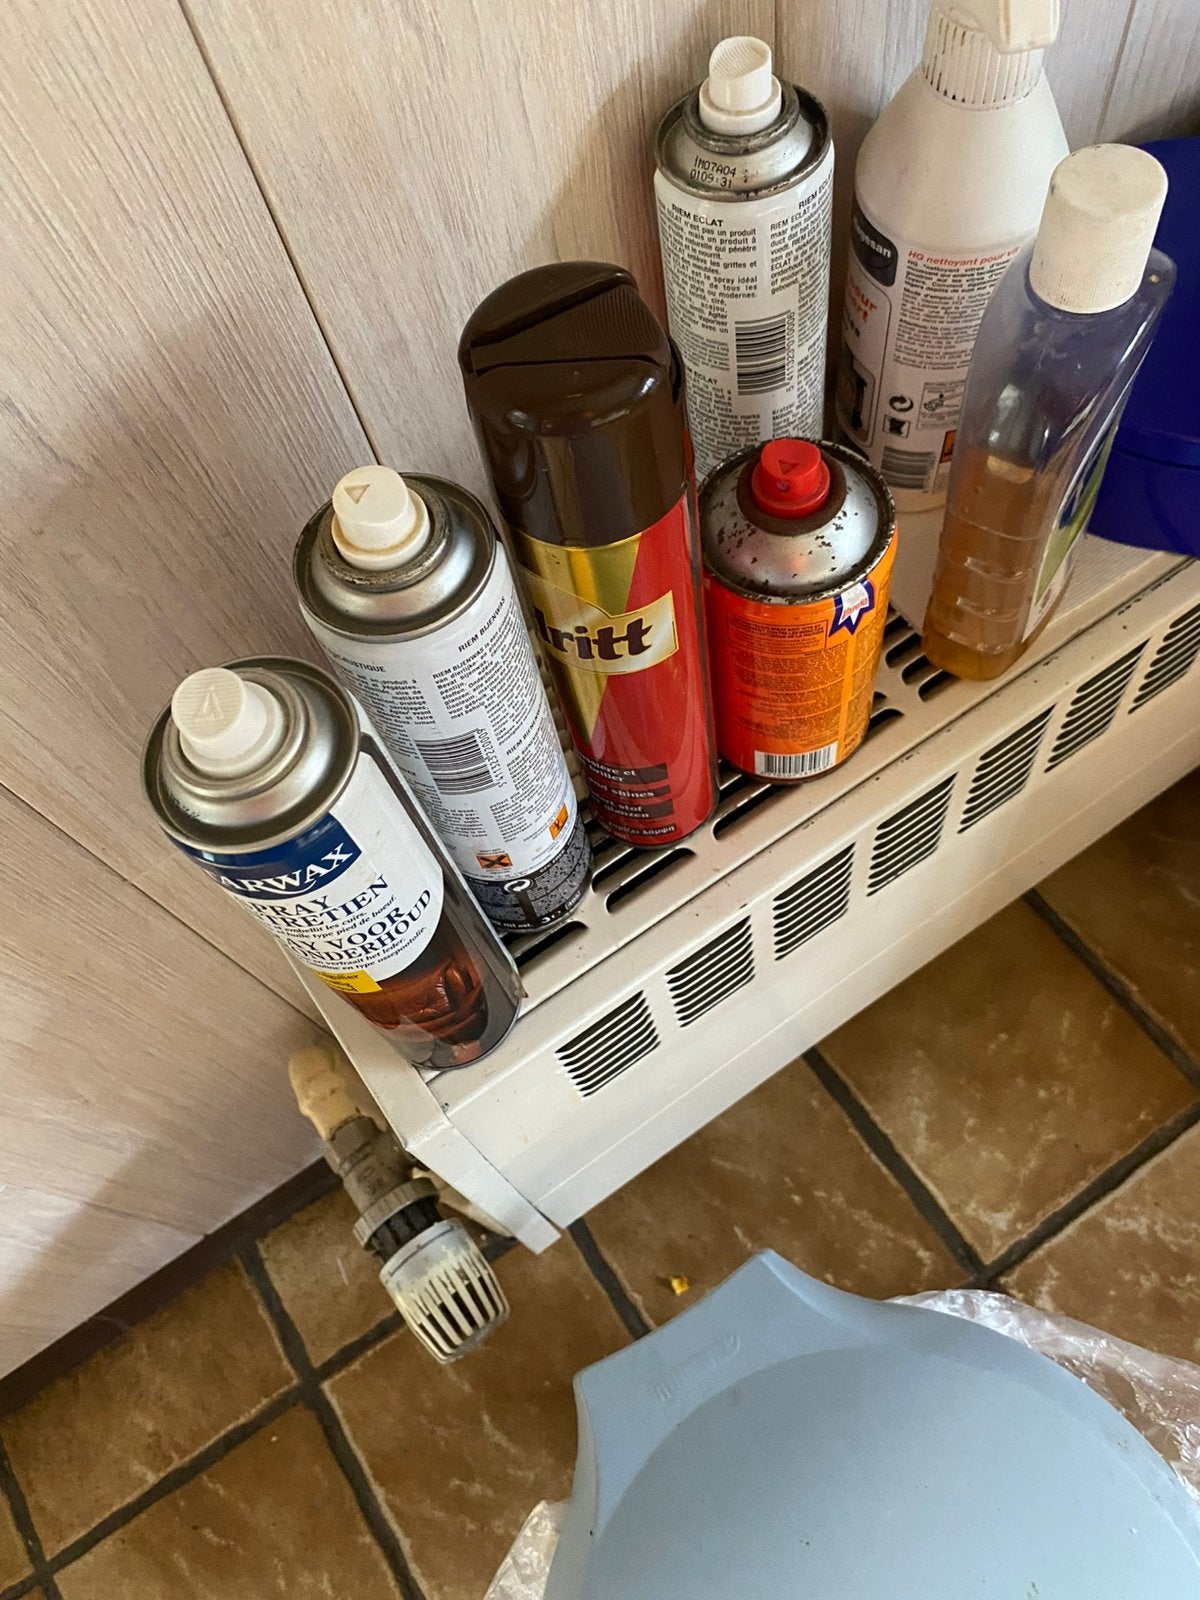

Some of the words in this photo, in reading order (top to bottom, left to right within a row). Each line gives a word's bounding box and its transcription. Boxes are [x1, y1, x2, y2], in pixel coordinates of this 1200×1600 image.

[798, 190, 818, 210] RIEM
[671, 203, 692, 220] RIEM
[693, 214, 724, 227] ECLAT
[770, 218, 789, 231] RIEM
[790, 206, 810, 223] ECLAT
[729, 228, 756, 239] produit
[707, 236, 717, 244] un
[719, 237, 749, 247] produit
[714, 245, 727, 253] qui
[709, 259, 721, 268] les
[723, 261, 747, 270] griffes
[749, 260, 758, 268] et
[926, 256, 978, 267] nettoyant
[979, 252, 1006, 266] pour
[709, 282, 719, 290] de
[723, 284, 741, 292] tous
[745, 284, 758, 292] les
[713, 276, 735, 285] spray
[737, 275, 758, 284] idéal
[718, 292, 758, 300] modernes.
[457, 633, 479, 653] RIEM
[479, 595, 505, 637] BIJENWAS
[432, 668, 451, 680] RIEM
[452, 646, 484, 673] BIJENWAS
[437, 679, 457, 690] Bevat
[450, 712, 464, 720] met
[611, 788, 655, 798] shines
[212, 843, 353, 892] ARWAX
[247, 896, 331, 917] PRAY
[260, 874, 389, 927] TRETIEN
[342, 911, 367, 925] cuirs.
[313, 931, 334, 939] type
[336, 923, 357, 936] pied
[359, 916, 370, 926] de
[326, 907, 405, 949] VOOR
[365, 951, 380, 962] het
[382, 937, 406, 954] leder.
[356, 961, 376, 970] type
